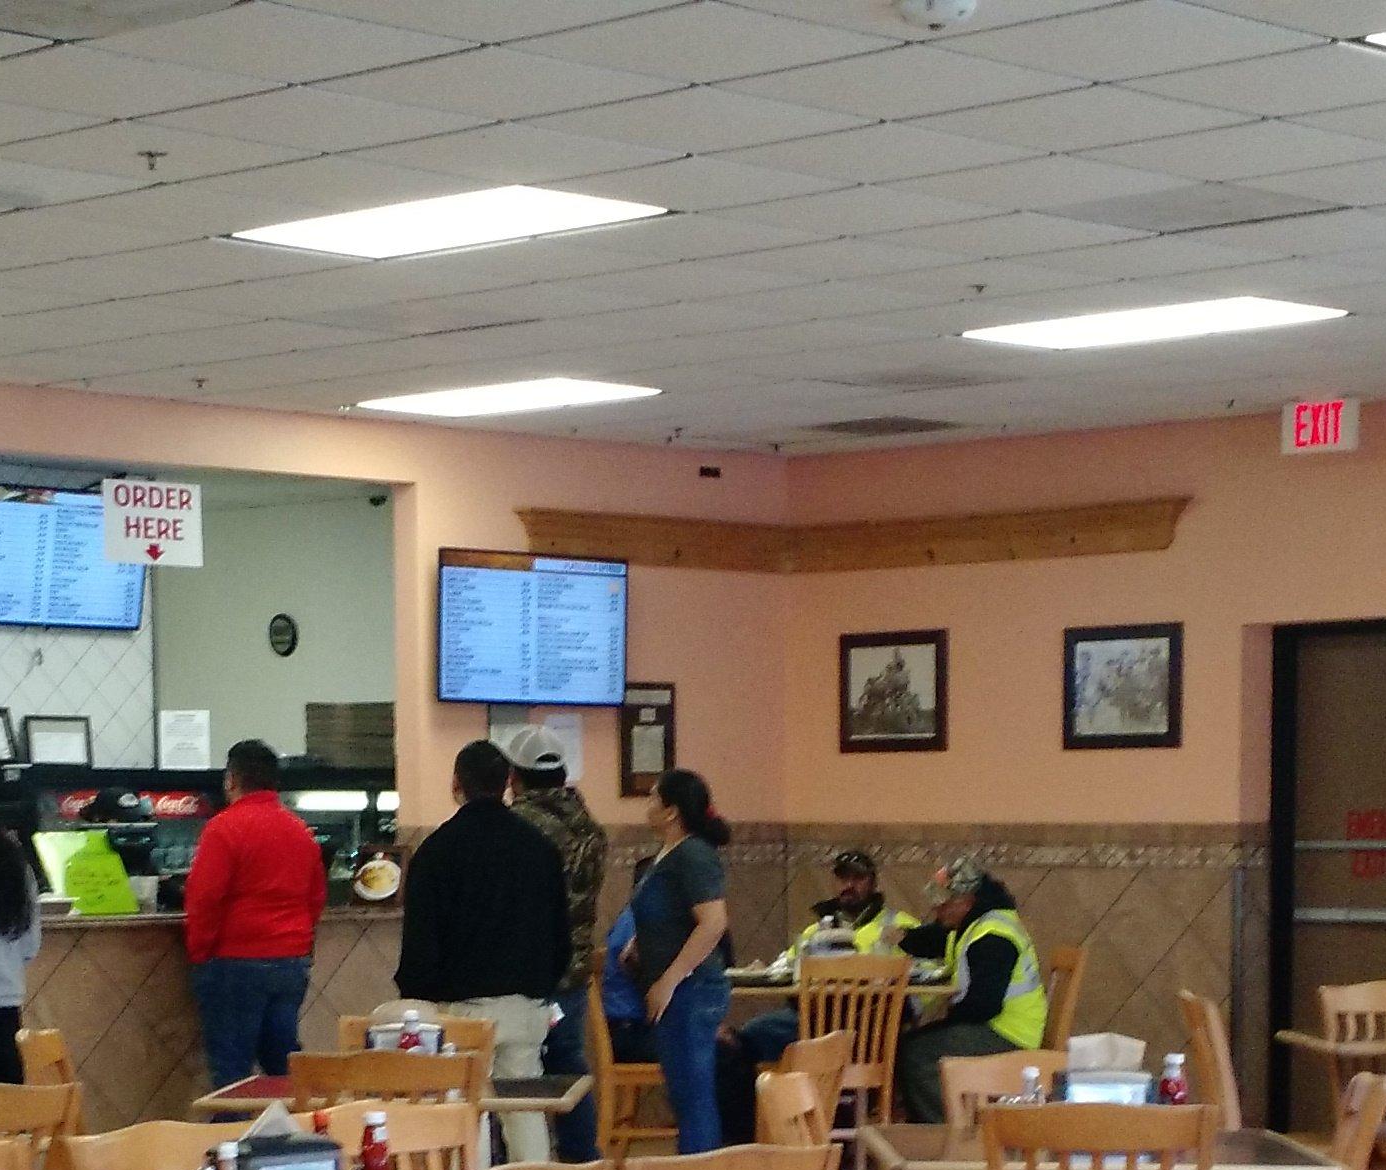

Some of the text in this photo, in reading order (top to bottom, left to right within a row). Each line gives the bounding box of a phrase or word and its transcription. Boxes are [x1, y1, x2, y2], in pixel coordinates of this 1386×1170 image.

[1294, 401, 1344, 448] EXIT
[113, 484, 193, 511] ORDER
[124, 515, 185, 541] HERE
